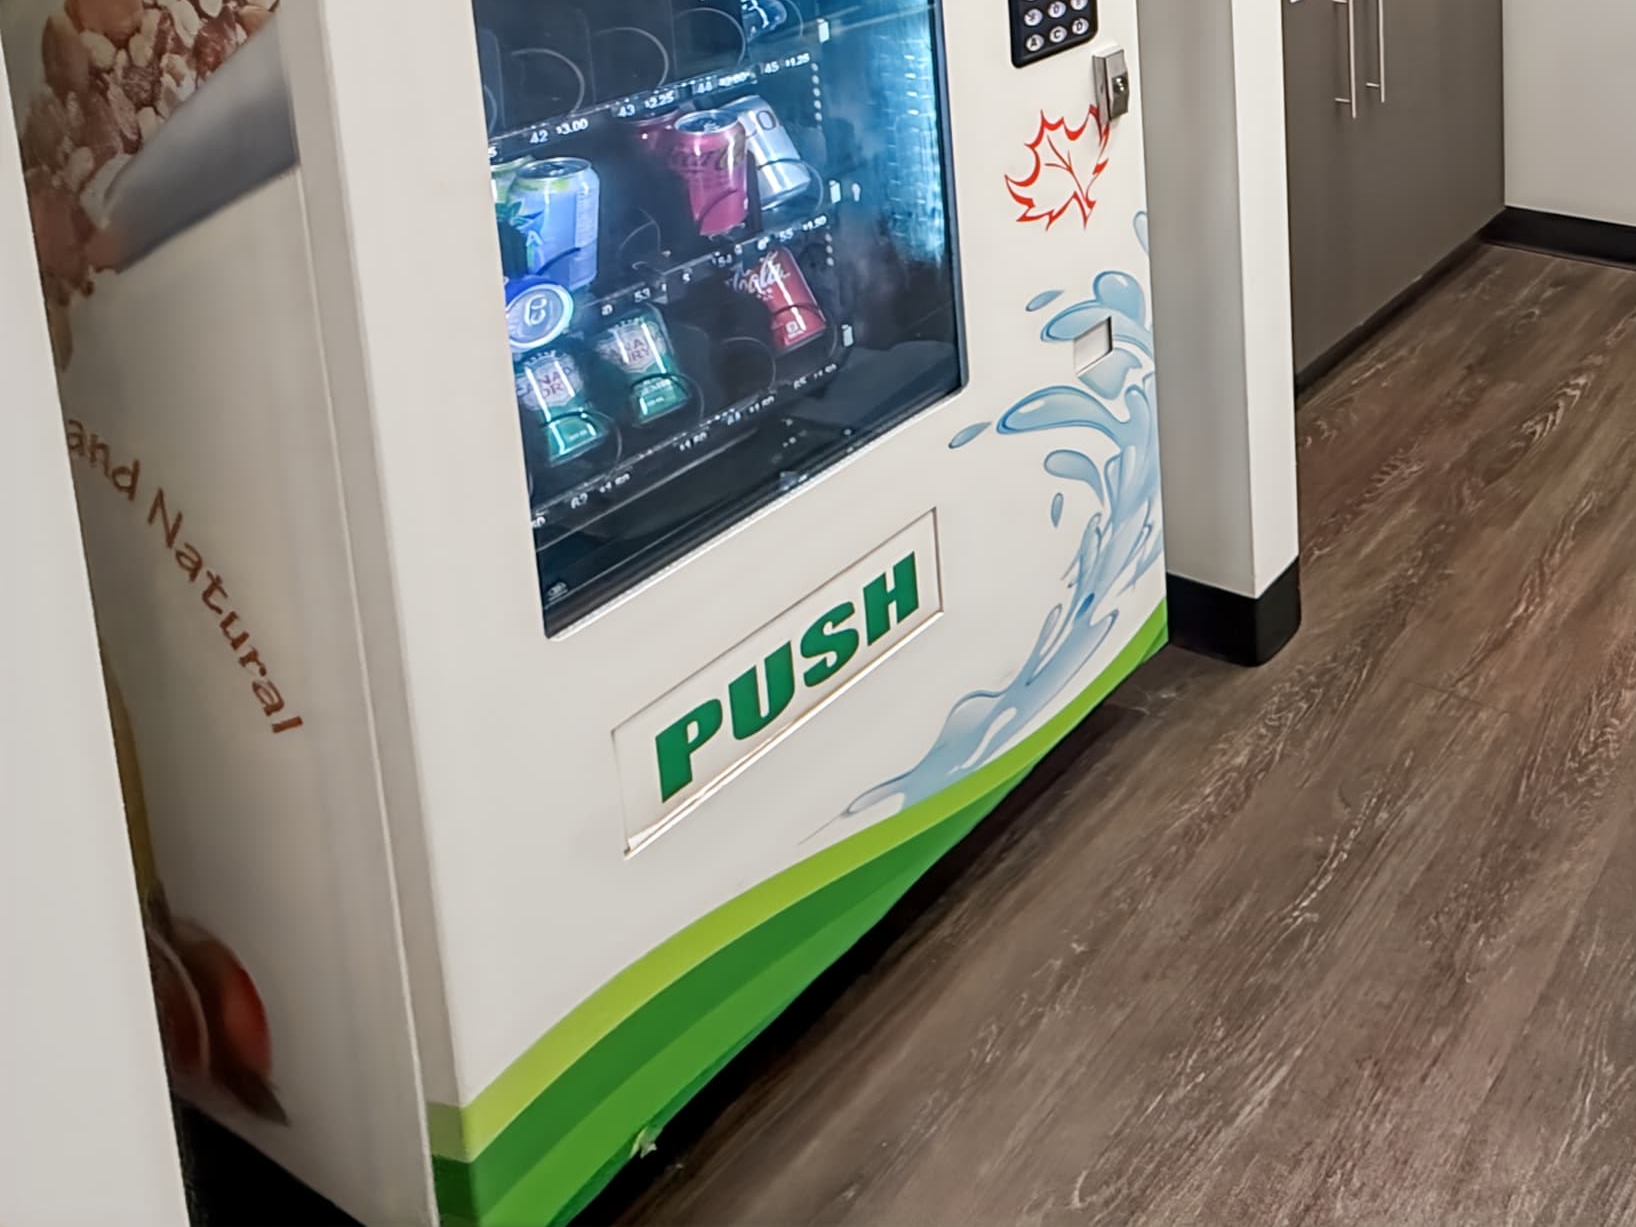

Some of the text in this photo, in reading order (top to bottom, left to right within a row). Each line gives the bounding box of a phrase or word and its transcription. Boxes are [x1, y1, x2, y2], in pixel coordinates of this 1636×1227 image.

[529, 118, 589, 144] 42 $3.00
[617, 104, 636, 118] 43
[66, 419, 303, 733] and Natural
[655, 551, 919, 803] PUSH
